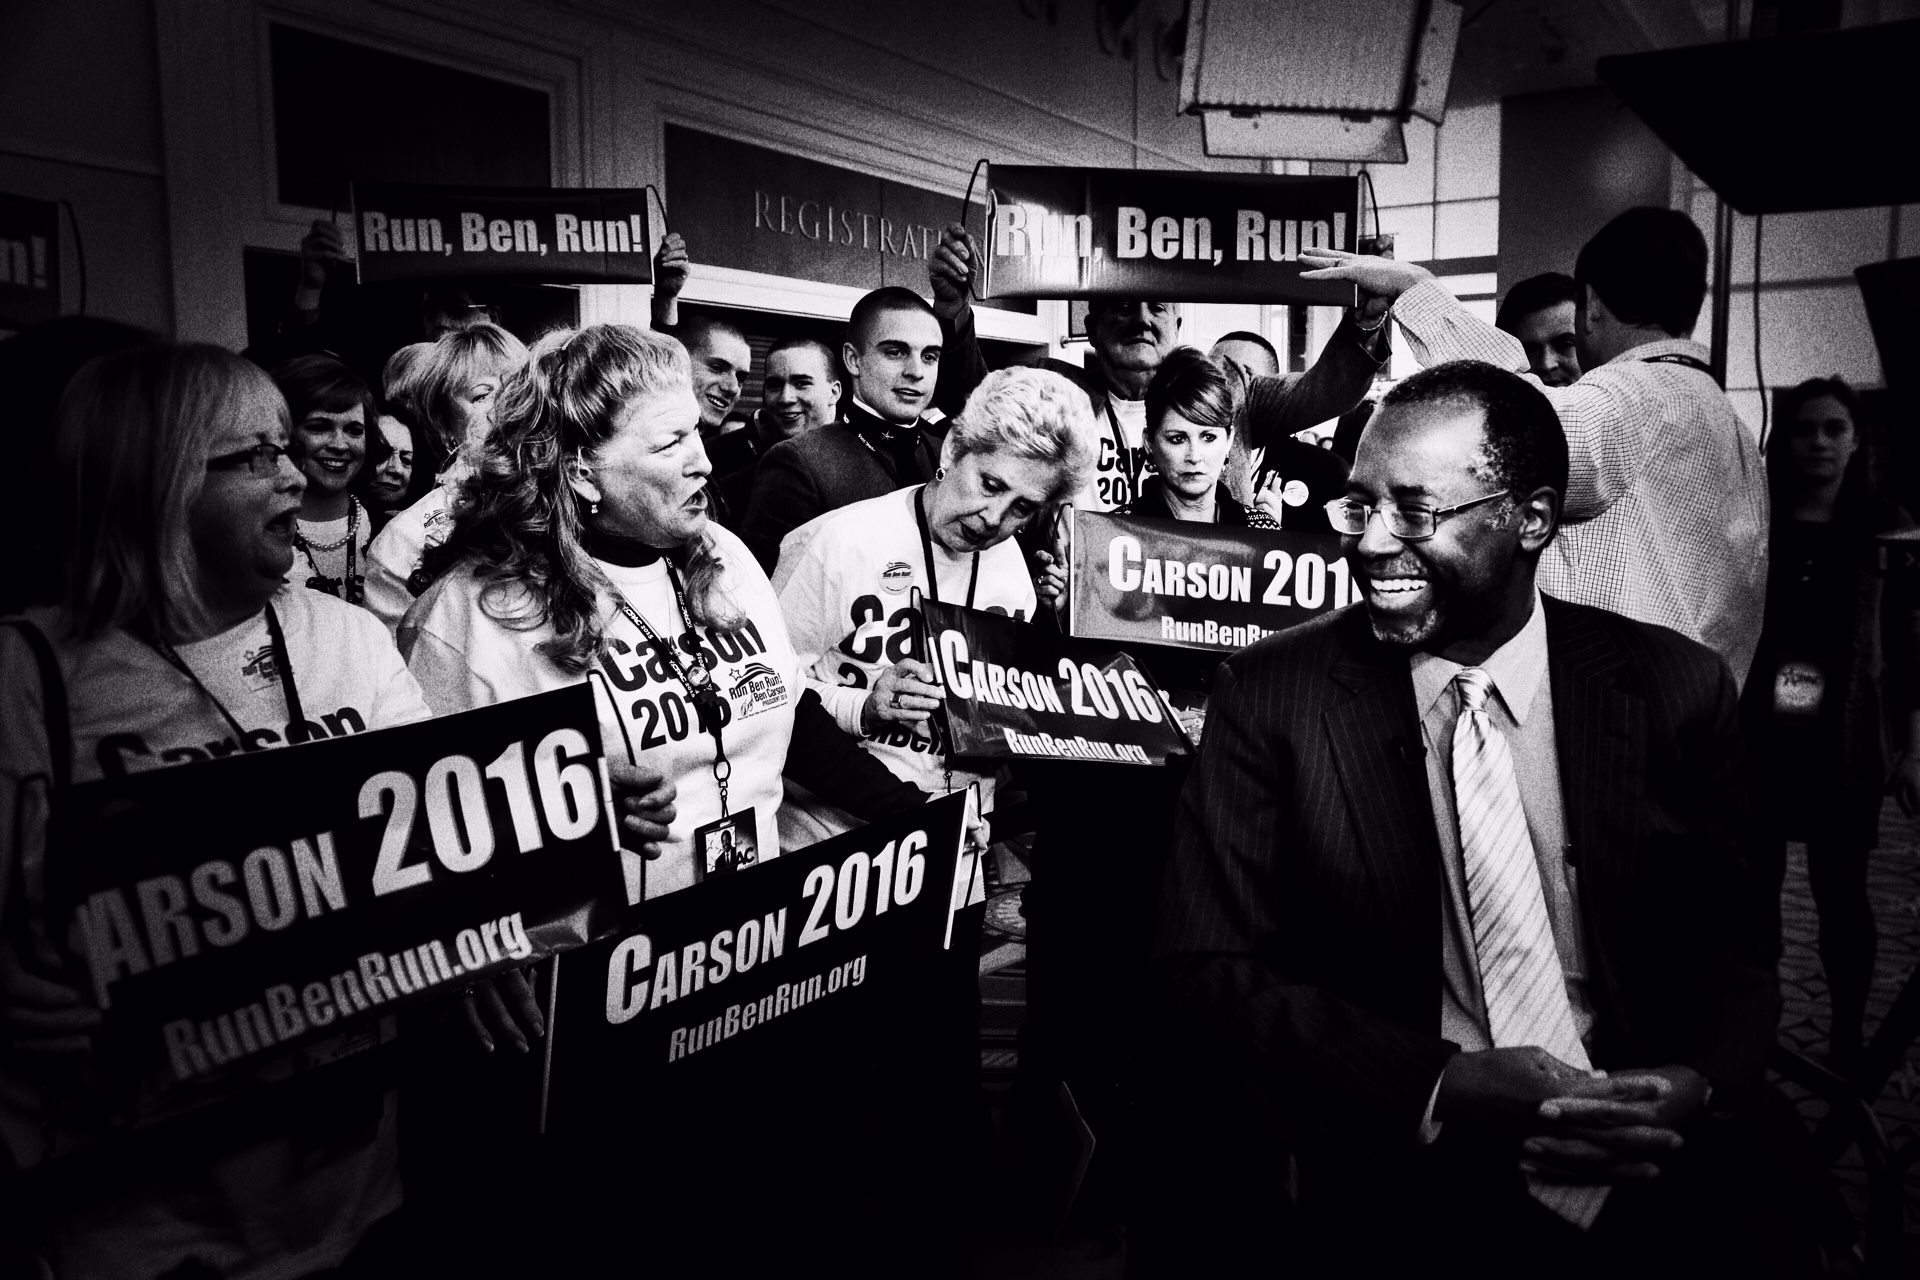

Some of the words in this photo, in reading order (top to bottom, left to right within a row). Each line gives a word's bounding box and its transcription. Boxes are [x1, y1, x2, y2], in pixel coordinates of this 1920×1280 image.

[362, 210, 453, 257] Run,
[460, 211, 549, 257] Ben,
[555, 213, 643, 253] Run!
[996, 203, 1103, 263] Run,
[1117, 206, 1224, 267] Ben,
[1236, 209, 1347, 262] Run!
[1108, 535, 1252, 603] CARSON
[1262, 549, 1364, 610] 201
[729, 686, 748, 700] Run
[748, 680, 766, 693] Ben
[764, 672, 783, 688] Run!
[753, 692, 768, 703] Ben
[939, 629, 1066, 715] CARSON
[1057, 656, 1163, 724] 2016
[1003, 727, 1152, 766] RunBenRun.org
[74, 829, 350, 1011] ARSON
[357, 727, 601, 898] 2016
[605, 905, 788, 1025] CARSON
[797, 828, 929, 949] 2016
[161, 911, 534, 1082] RunBenRun.org
[668, 953, 868, 1064] RunBenRun.org
